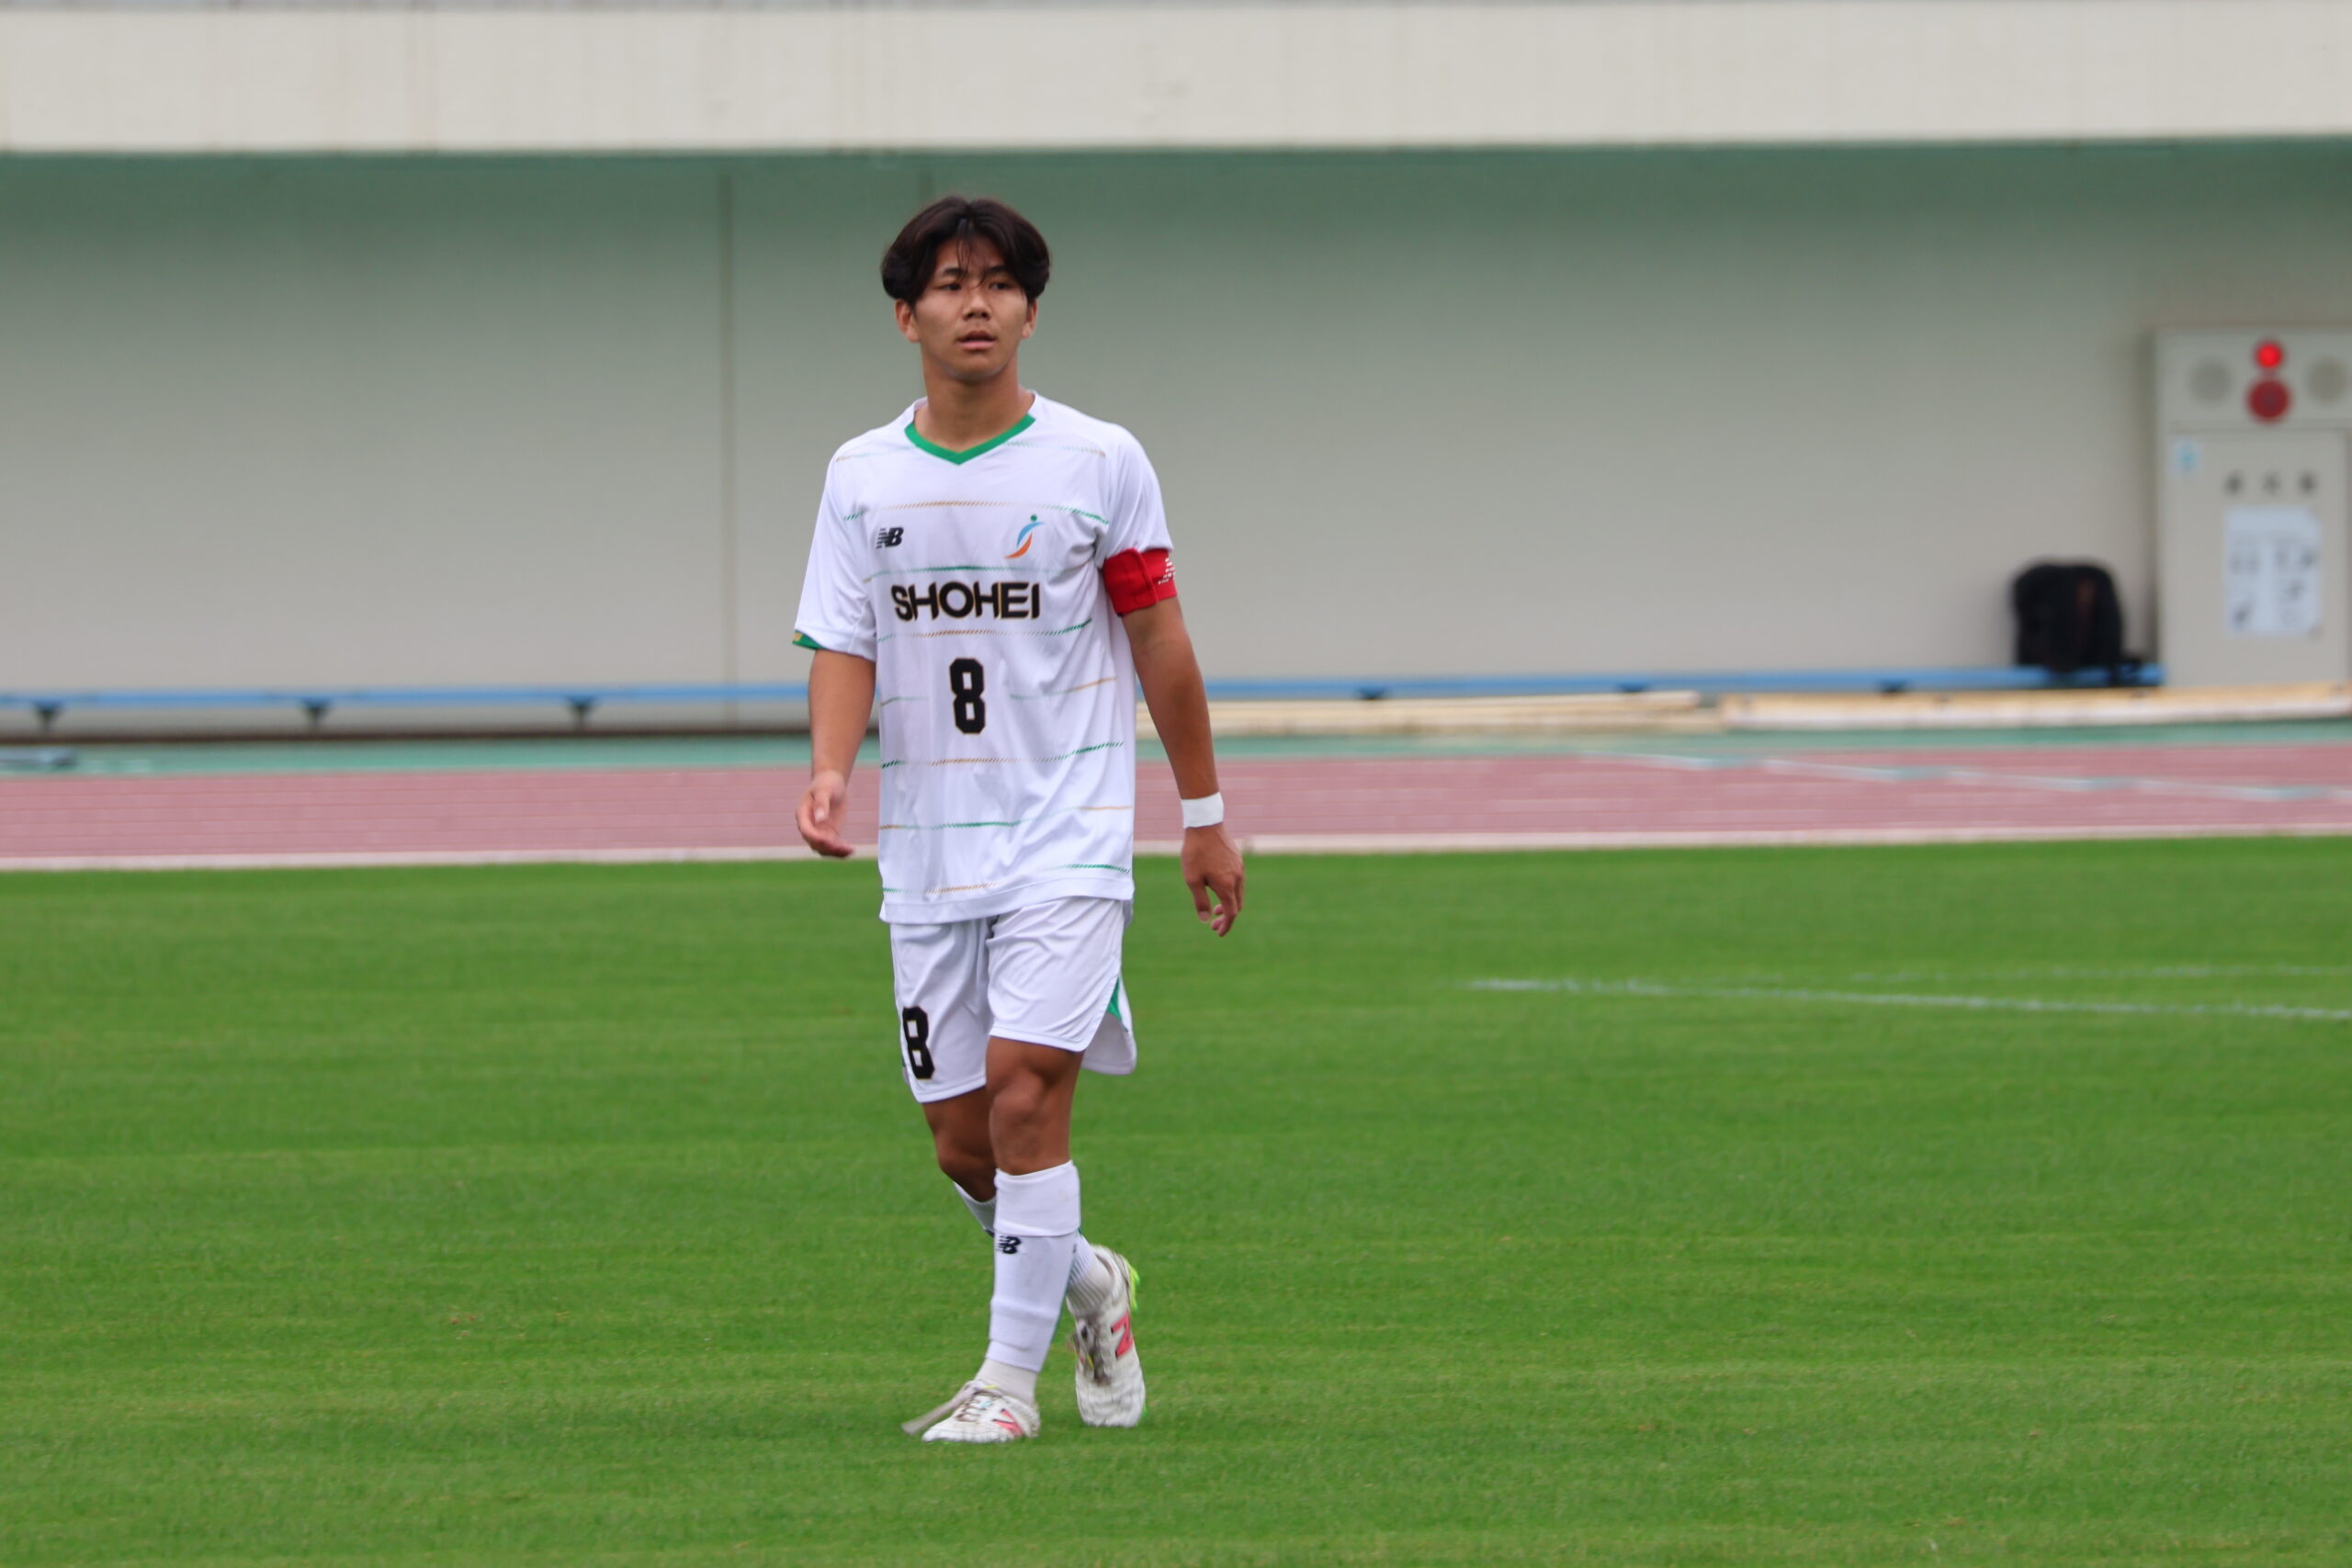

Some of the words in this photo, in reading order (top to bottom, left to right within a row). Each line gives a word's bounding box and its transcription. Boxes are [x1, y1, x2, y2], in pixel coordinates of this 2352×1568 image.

[890, 581, 1041, 621] SHOHEI
[949, 657, 986, 735] 8
[902, 1006, 935, 1080] 8
